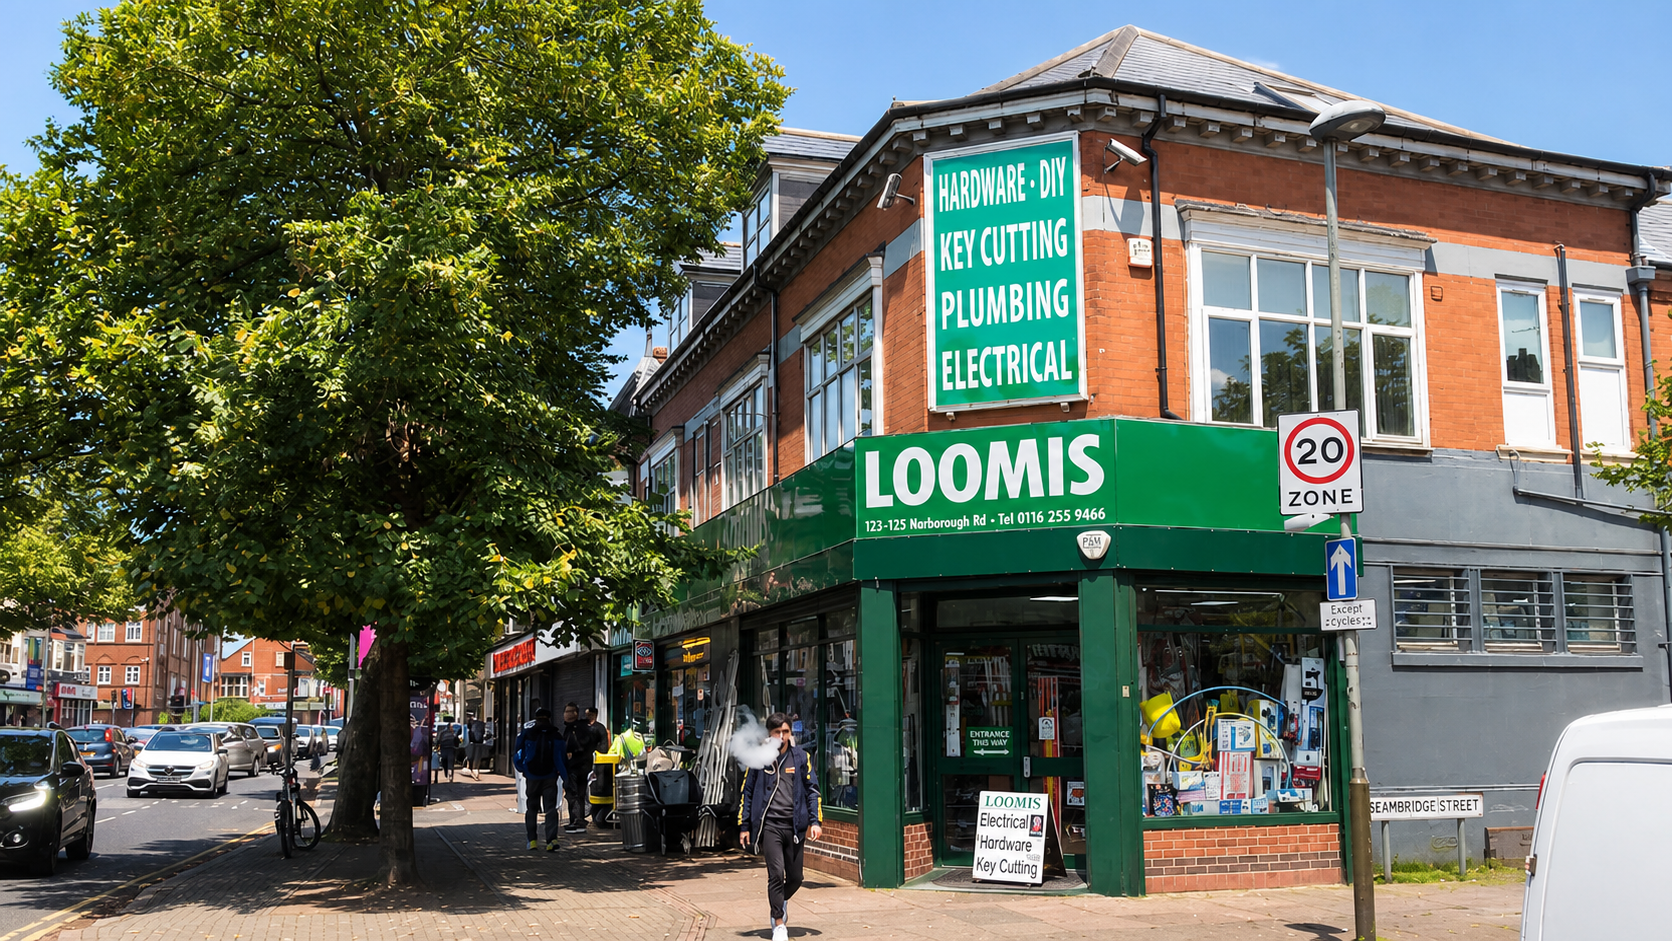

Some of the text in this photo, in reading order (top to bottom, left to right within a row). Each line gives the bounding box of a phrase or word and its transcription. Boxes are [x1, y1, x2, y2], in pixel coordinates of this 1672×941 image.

[939, 156, 1067, 212] HARDWARE DIY
[940, 217, 1068, 271] KEY CUTTING
[941, 278, 1069, 330] PLUMBING
[941, 339, 1073, 391] ELECTRICAL
[1296, 437, 1343, 465] 20
[865, 433, 1105, 508] LOOMIS
[1288, 488, 1353, 506] ZONE
[865, 507, 1106, 532] 123-125 Narborough Rd Tel 0116 255 9466
[1331, 604, 1362, 615] Except
[970, 730, 1010, 738] ENTRANCE
[985, 795, 1041, 810] LOOMIS
[1440, 799, 1479, 812] STREET
[980, 812, 1029, 829] Electrical
[980, 834, 1032, 852] Hardware
[976, 857, 1038, 879] Key Cutting
